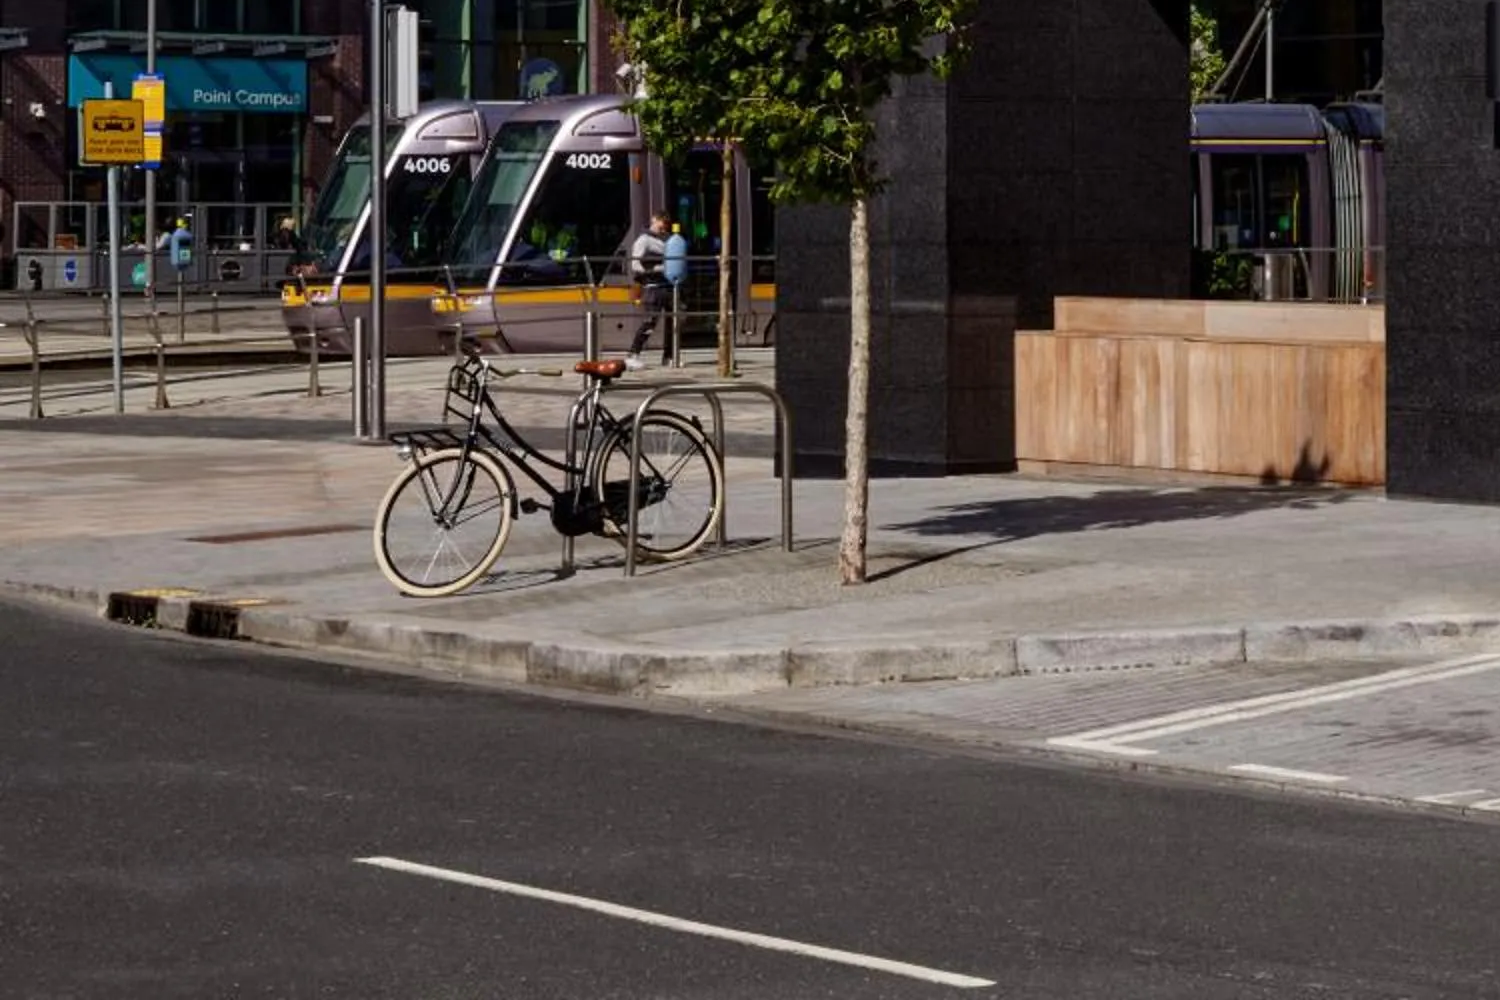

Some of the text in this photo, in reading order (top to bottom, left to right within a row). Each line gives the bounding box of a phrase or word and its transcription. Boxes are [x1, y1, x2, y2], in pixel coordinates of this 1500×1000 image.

[193, 88, 301, 108] Point Campus
[403, 157, 451, 173] 4006
[566, 153, 612, 169] 4002
